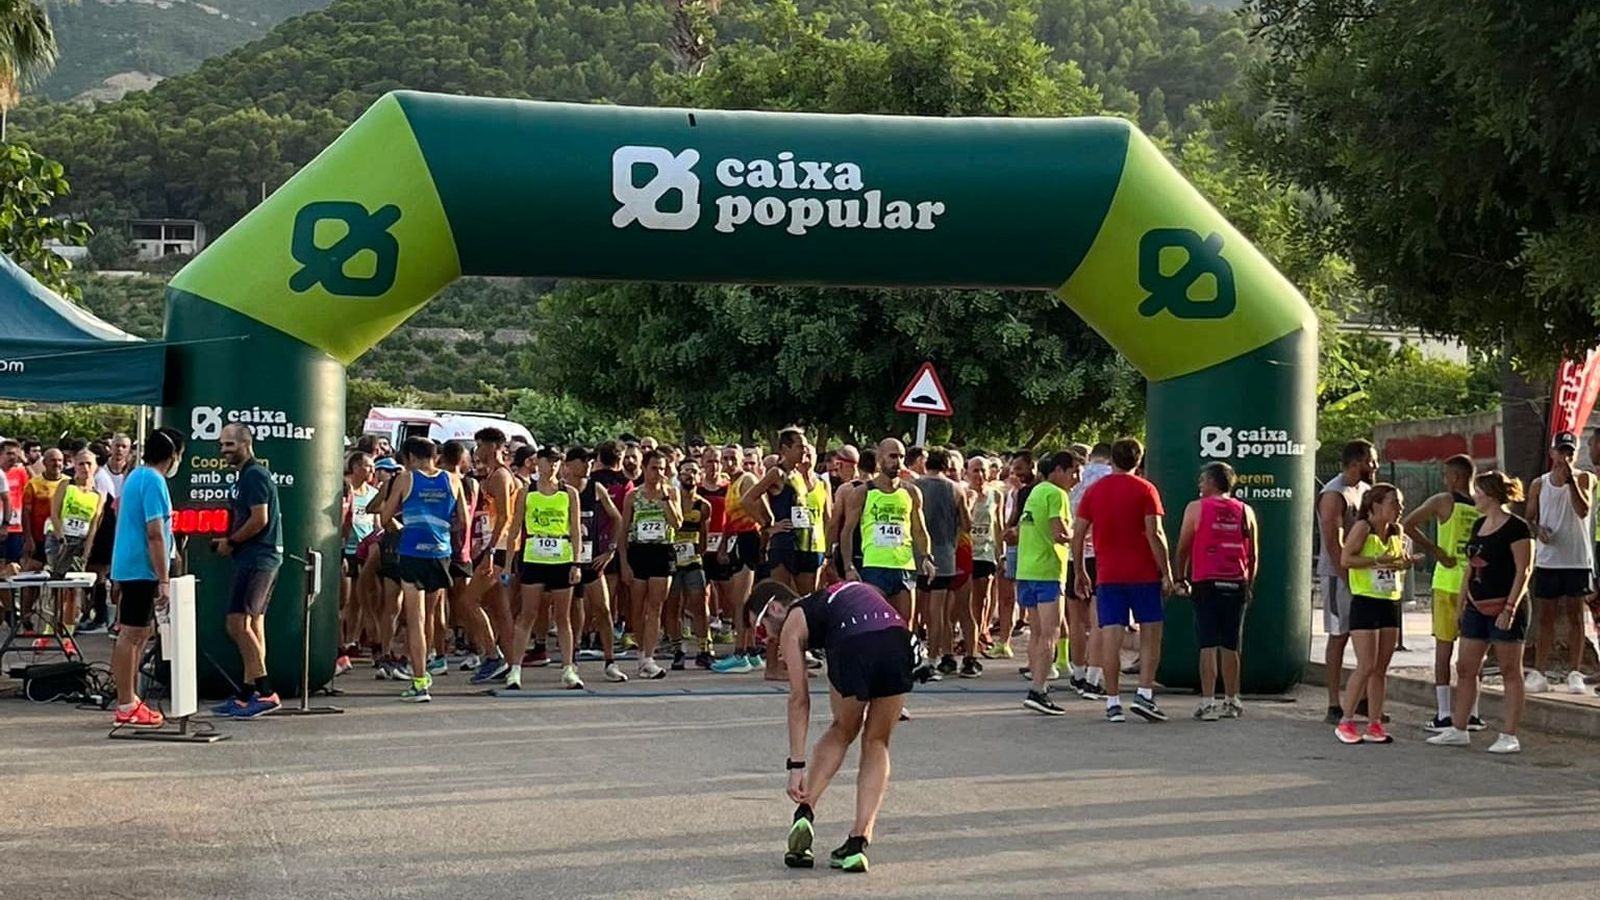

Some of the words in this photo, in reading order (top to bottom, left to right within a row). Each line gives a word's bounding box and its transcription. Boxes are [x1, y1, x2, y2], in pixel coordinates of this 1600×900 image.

[716, 151, 864, 191] caixa
[714, 190, 946, 235] popular
[227, 406, 287, 423] caixa
[248, 422, 315, 441] pular
[1237, 426, 1288, 442] caixa
[1236, 440, 1306, 458] popular
[191, 456, 269, 469] Coopm
[190, 471, 221, 484] amb
[1235, 486, 1248, 498] el
[1252, 487, 1293, 498] nostre
[642, 522, 661, 531] 272
[879, 525, 901, 536] 146
[539, 539, 558, 548] 103
